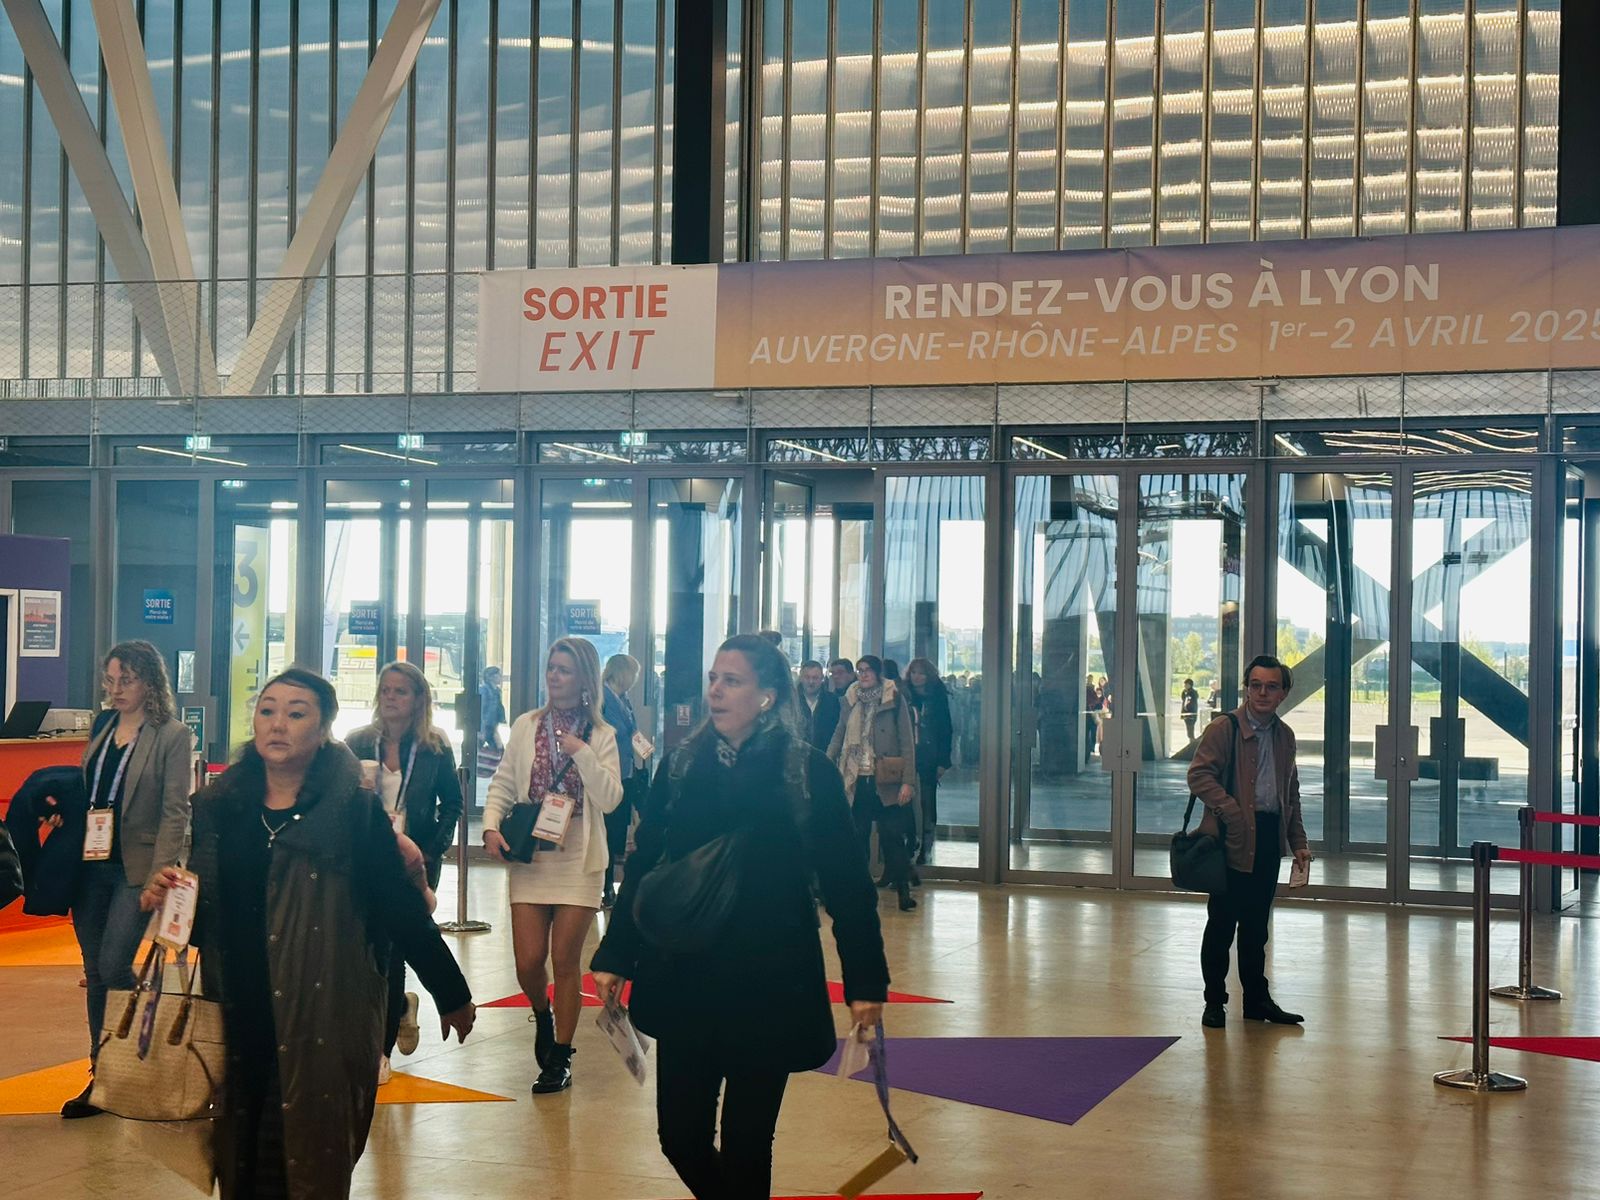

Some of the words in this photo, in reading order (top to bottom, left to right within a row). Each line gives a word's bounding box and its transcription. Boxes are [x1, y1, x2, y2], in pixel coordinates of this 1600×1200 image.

[522, 284, 669, 321] SORTIE
[884, 272, 1235, 320] RENDEZ-VOUS
[1248, 258, 1283, 308] À
[1299, 263, 1440, 306] LYON
[538, 330, 656, 372] EXIT
[749, 321, 1239, 364] AUVERGNE-RHÔNE-ALPES
[1368, 314, 1490, 348] AVRIL
[145, 598, 172, 609] SORTIE
[351, 609, 378, 619] SORTIE
[570, 607, 598, 618] SORTIE
